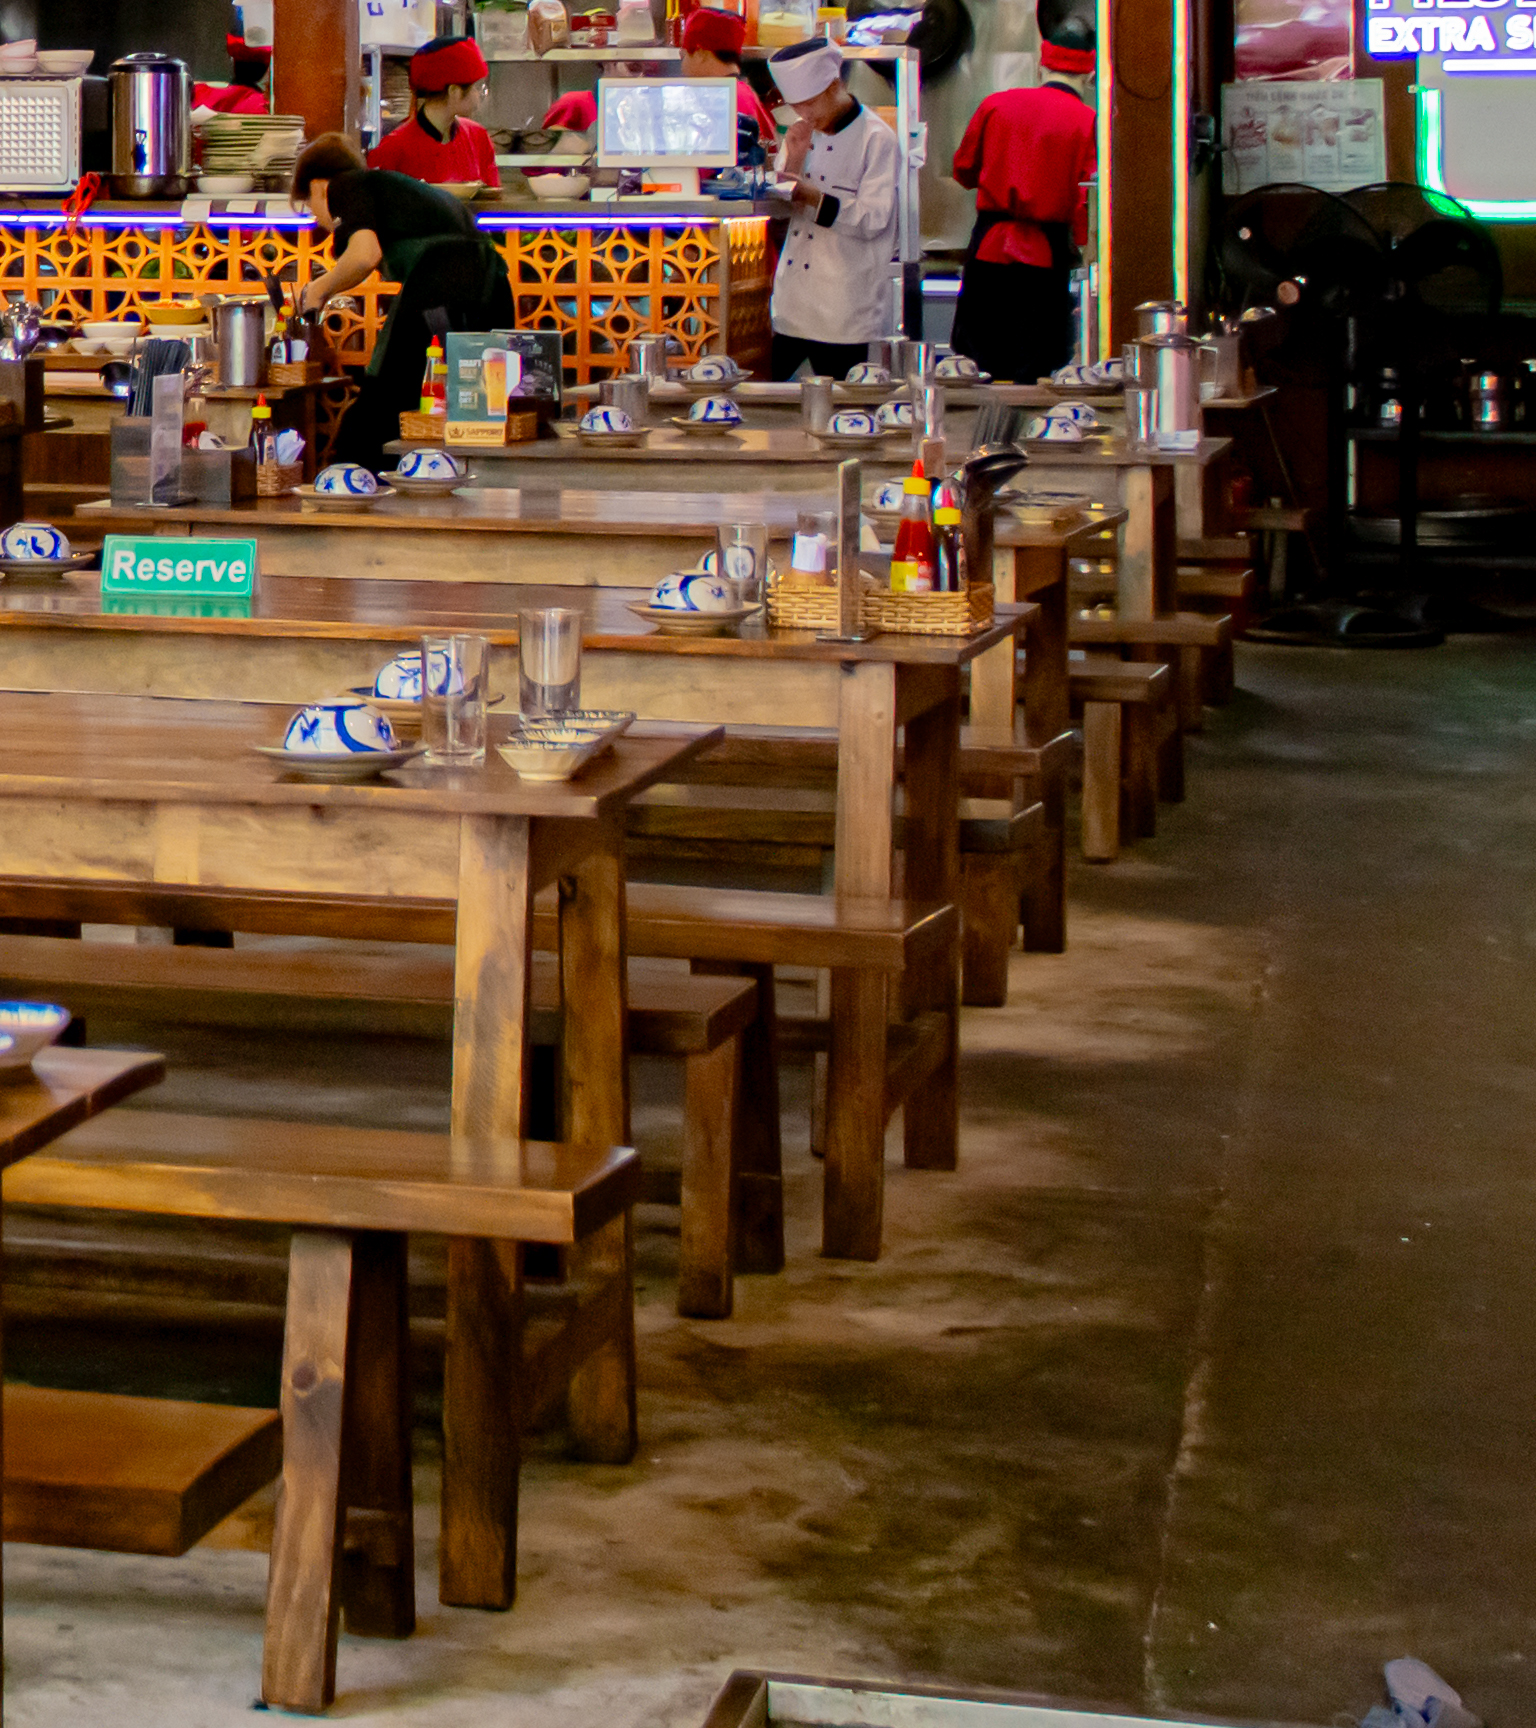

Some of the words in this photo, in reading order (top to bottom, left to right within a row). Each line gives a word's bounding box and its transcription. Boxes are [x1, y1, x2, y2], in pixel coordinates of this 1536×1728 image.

[1368, 15, 1496, 53] EXTRA
[1505, 14, 1536, 51] S
[111, 549, 247, 584] Reserve
